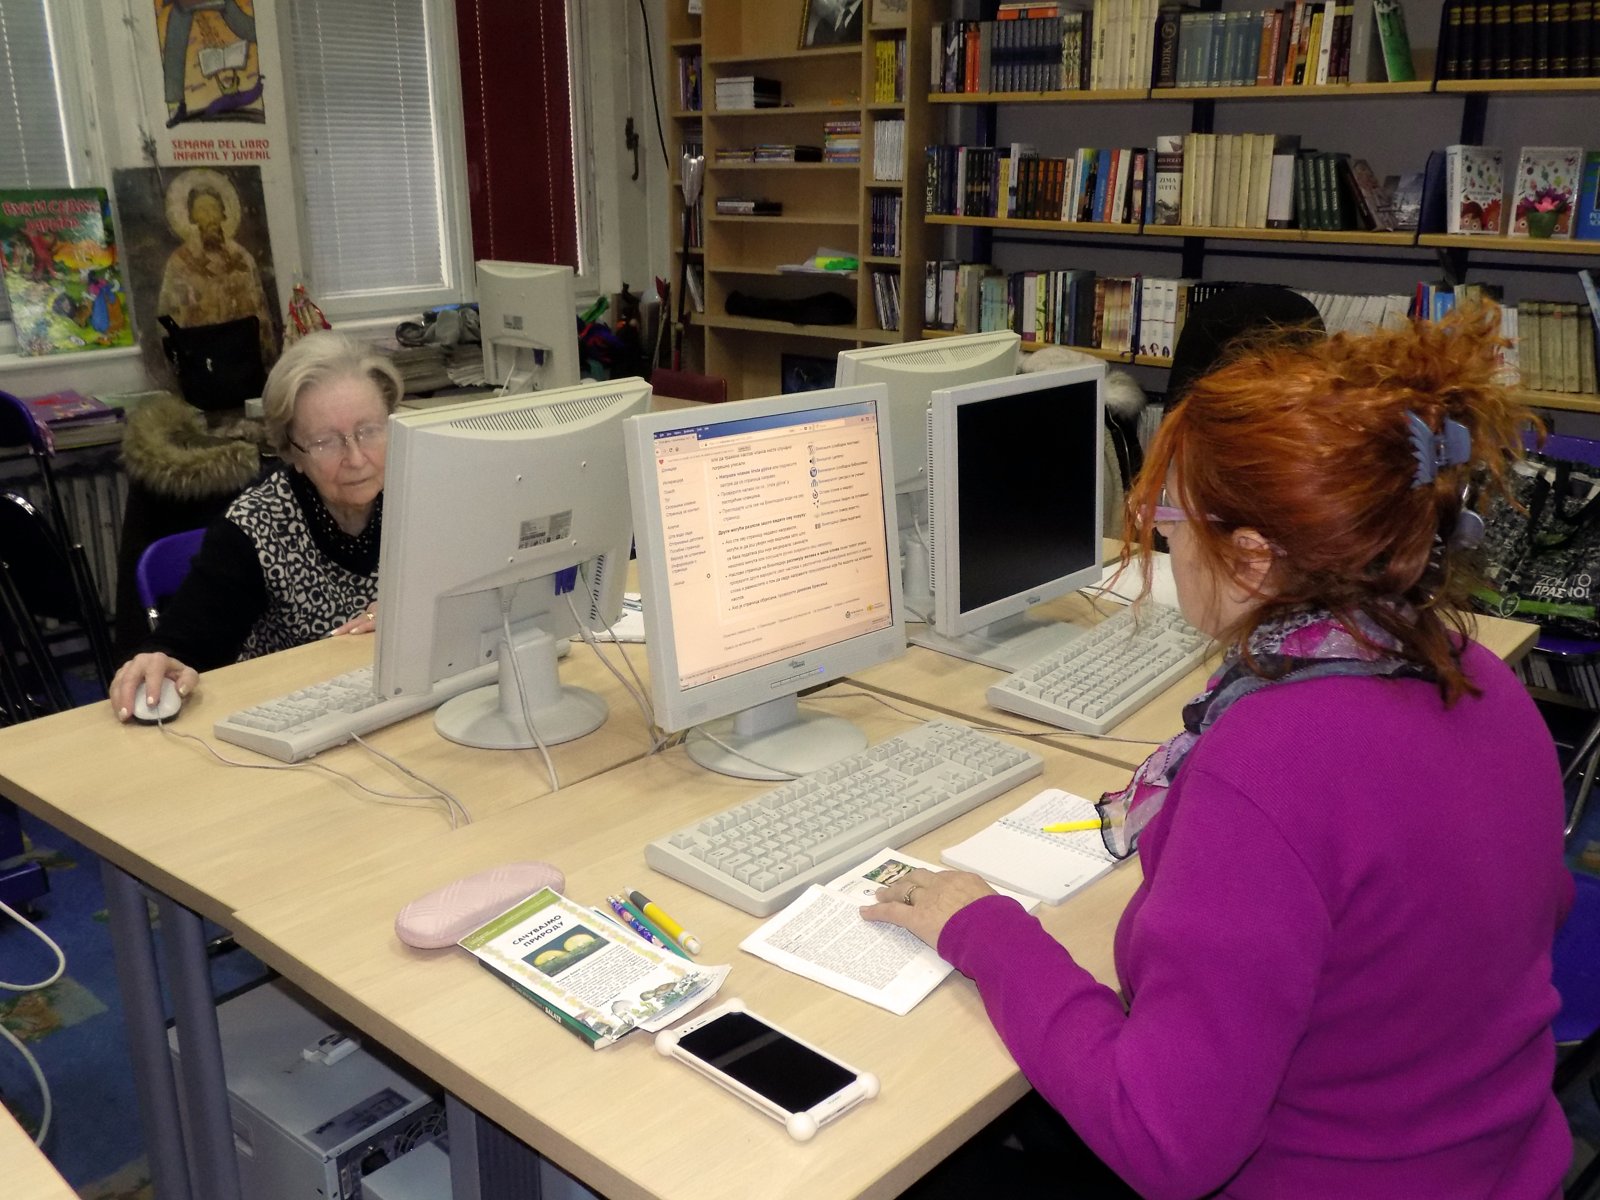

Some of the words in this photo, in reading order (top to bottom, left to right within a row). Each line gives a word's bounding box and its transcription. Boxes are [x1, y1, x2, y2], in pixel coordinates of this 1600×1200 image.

[172, 139, 215, 149] SEMANA
[218, 139, 236, 149] DEL
[240, 139, 270, 149] LIBRO
[174, 151, 219, 161] INFANTIL
[223, 151, 228, 161] Y
[232, 151, 272, 162] JUVENIL
[512, 914, 562, 945] САЧУВАЈМО
[523, 921, 564, 947] ПРИРОДУ
